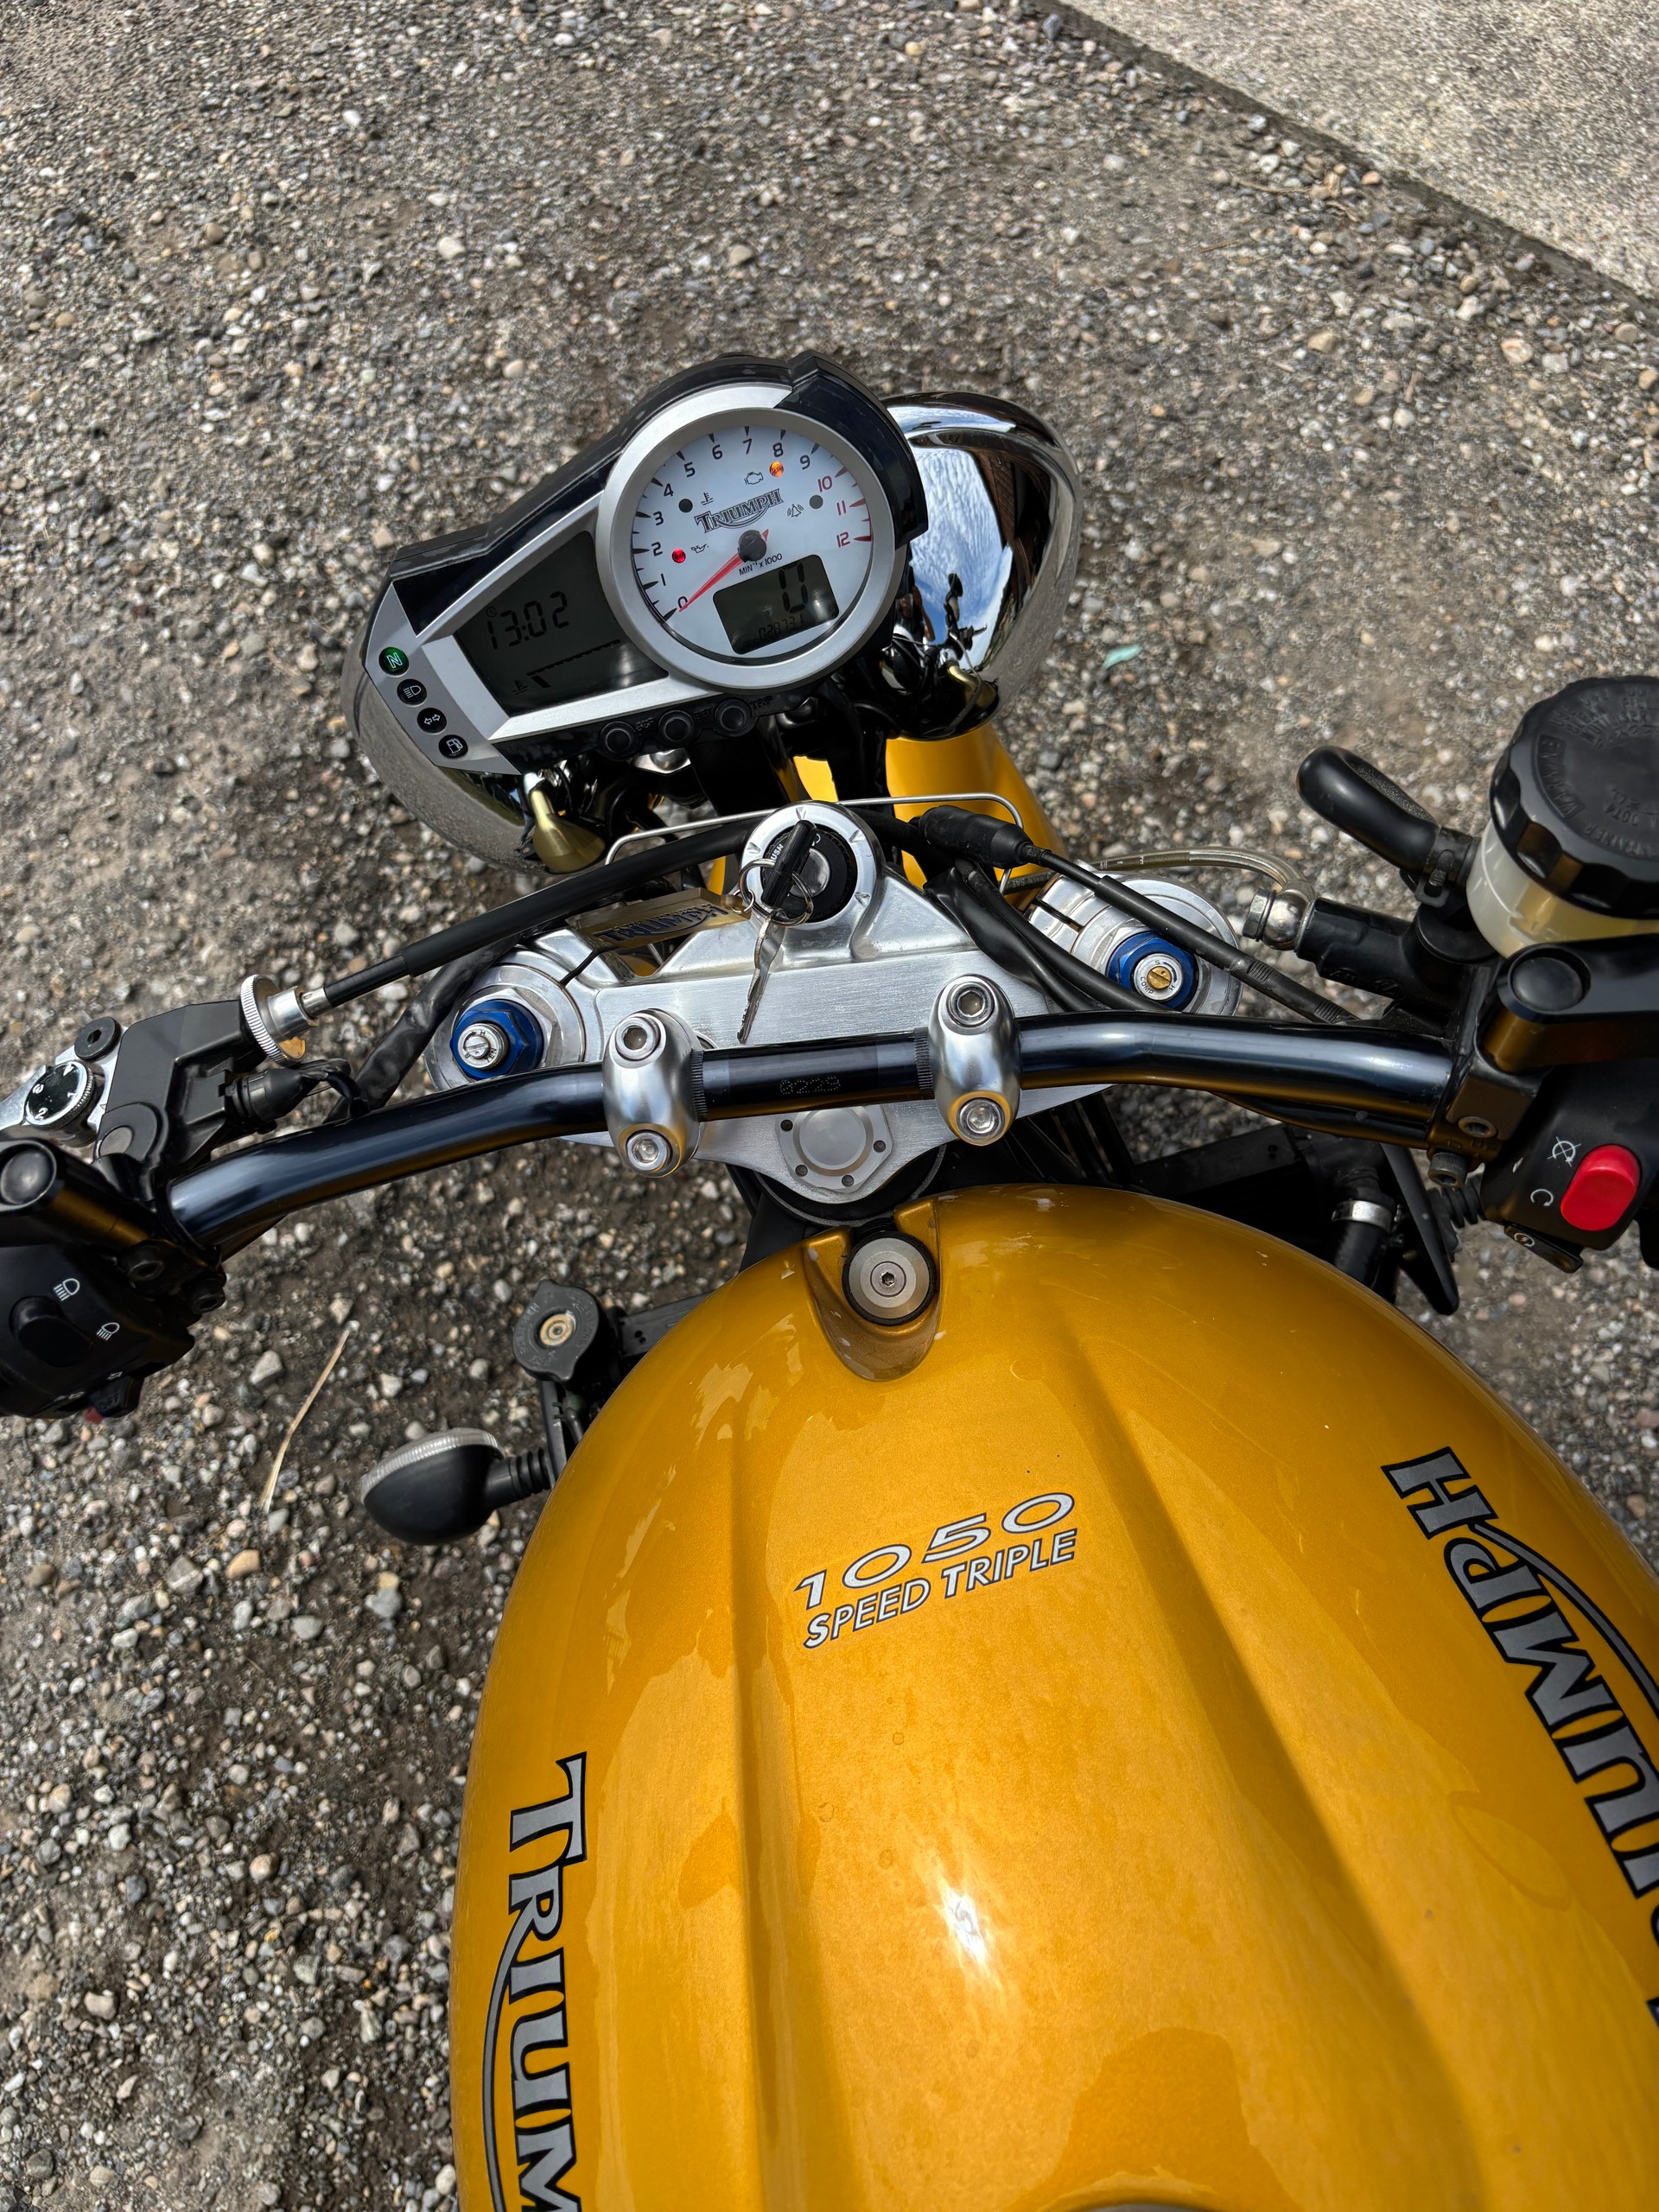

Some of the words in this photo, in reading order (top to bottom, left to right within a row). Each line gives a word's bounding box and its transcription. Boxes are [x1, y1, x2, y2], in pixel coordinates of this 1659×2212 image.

[712, 445, 723, 460] 6
[742, 439, 753, 454] 7
[772, 442, 784, 457] 8
[683, 462, 696, 478] 5
[799, 455, 811, 470] 9
[663, 483, 674, 497] 4
[818, 475, 833, 493] 10
[694, 488, 784, 533] TRIUMPH
[836, 500, 846, 516] 11
[653, 512, 664, 524] 3
[836, 532, 849, 548] 12
[651, 542, 663, 556] 2
[765, 553, 783, 566] 1000
[661, 574, 665, 586] 1
[779, 562, 808, 613] 0
[677, 595, 689, 610] 0
[486, 590, 569, 650] 13:02
[386, 652, 403, 669] N
[771, 843, 784, 863] USH
[594, 904, 728, 941] TRIUMPH
[1141, 976, 1154, 994] COMP
[486, 1047, 497, 1063] TEN
[793, 1491, 1075, 1611] 1050
[803, 1578, 931, 1649] SPEED
[941, 1527, 1077, 1599] TRIPLE
